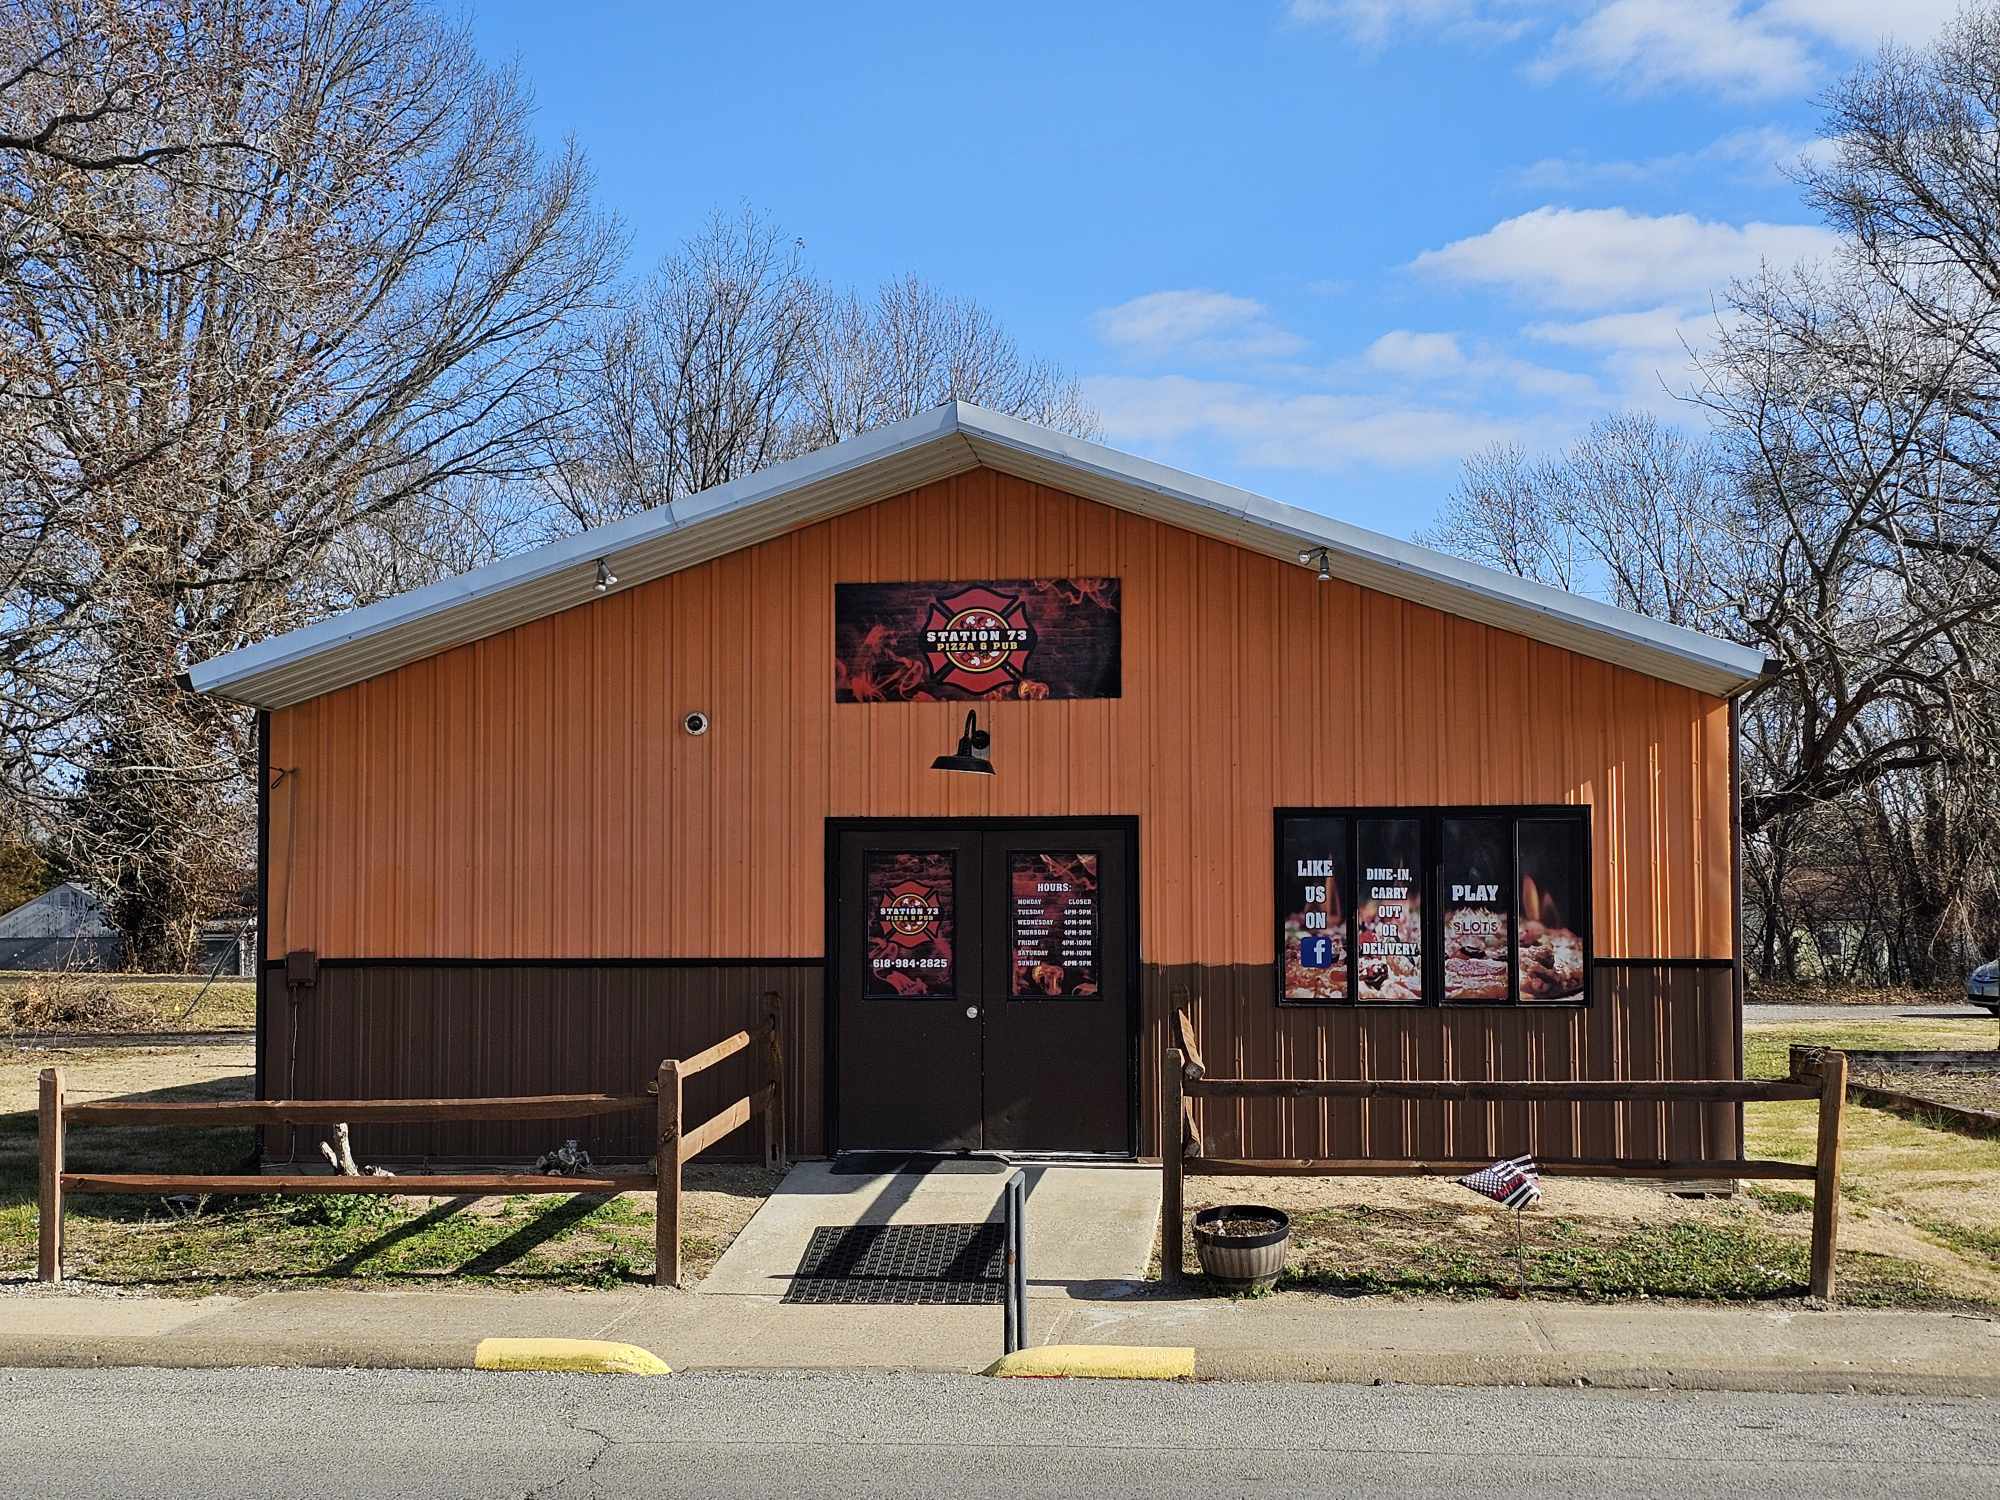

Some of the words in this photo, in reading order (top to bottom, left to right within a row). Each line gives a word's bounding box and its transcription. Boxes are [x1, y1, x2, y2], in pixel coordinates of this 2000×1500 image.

[926, 630, 1000, 642] STATION
[1007, 630, 1027, 641] 73
[937, 642, 975, 651] PIZZA
[993, 642, 1018, 650] PUB
[1297, 859, 1333, 877] LIKE
[1366, 868, 1412, 882] DINE-IN,
[1037, 883, 1072, 892] HOURS:
[1371, 887, 1408, 900] CARRY
[1451, 885, 1499, 901] PLAY
[1305, 886, 1326, 903] US
[1378, 906, 1402, 918] OUT
[1305, 912, 1326, 929] ON
[1382, 924, 1398, 937] OR
[1453, 921, 1498, 935] SLOTS
[1362, 943, 1417, 956] DELIVERY
